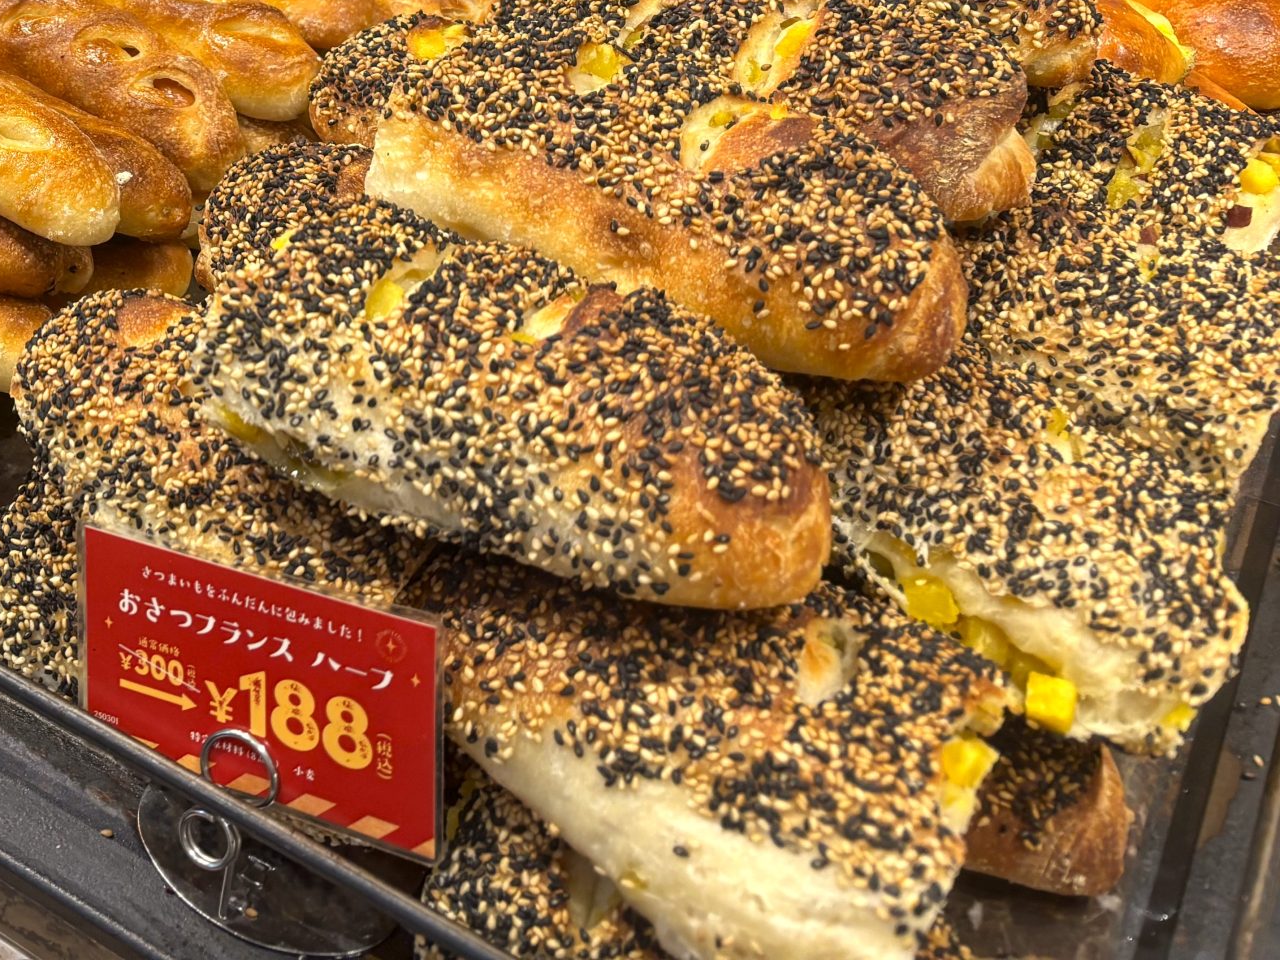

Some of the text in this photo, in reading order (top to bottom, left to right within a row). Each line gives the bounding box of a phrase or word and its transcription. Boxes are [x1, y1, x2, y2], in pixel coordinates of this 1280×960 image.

[141, 565, 364, 643] さつまいもをふんだんに包みました！
[119, 588, 394, 690] おさつフランス ハーフ
[119, 649, 184, 686] ¥300
[138, 636, 180, 657] 通常価格
[93, 710, 118, 725] 250301
[205, 671, 393, 780] ¥188 (税込)
